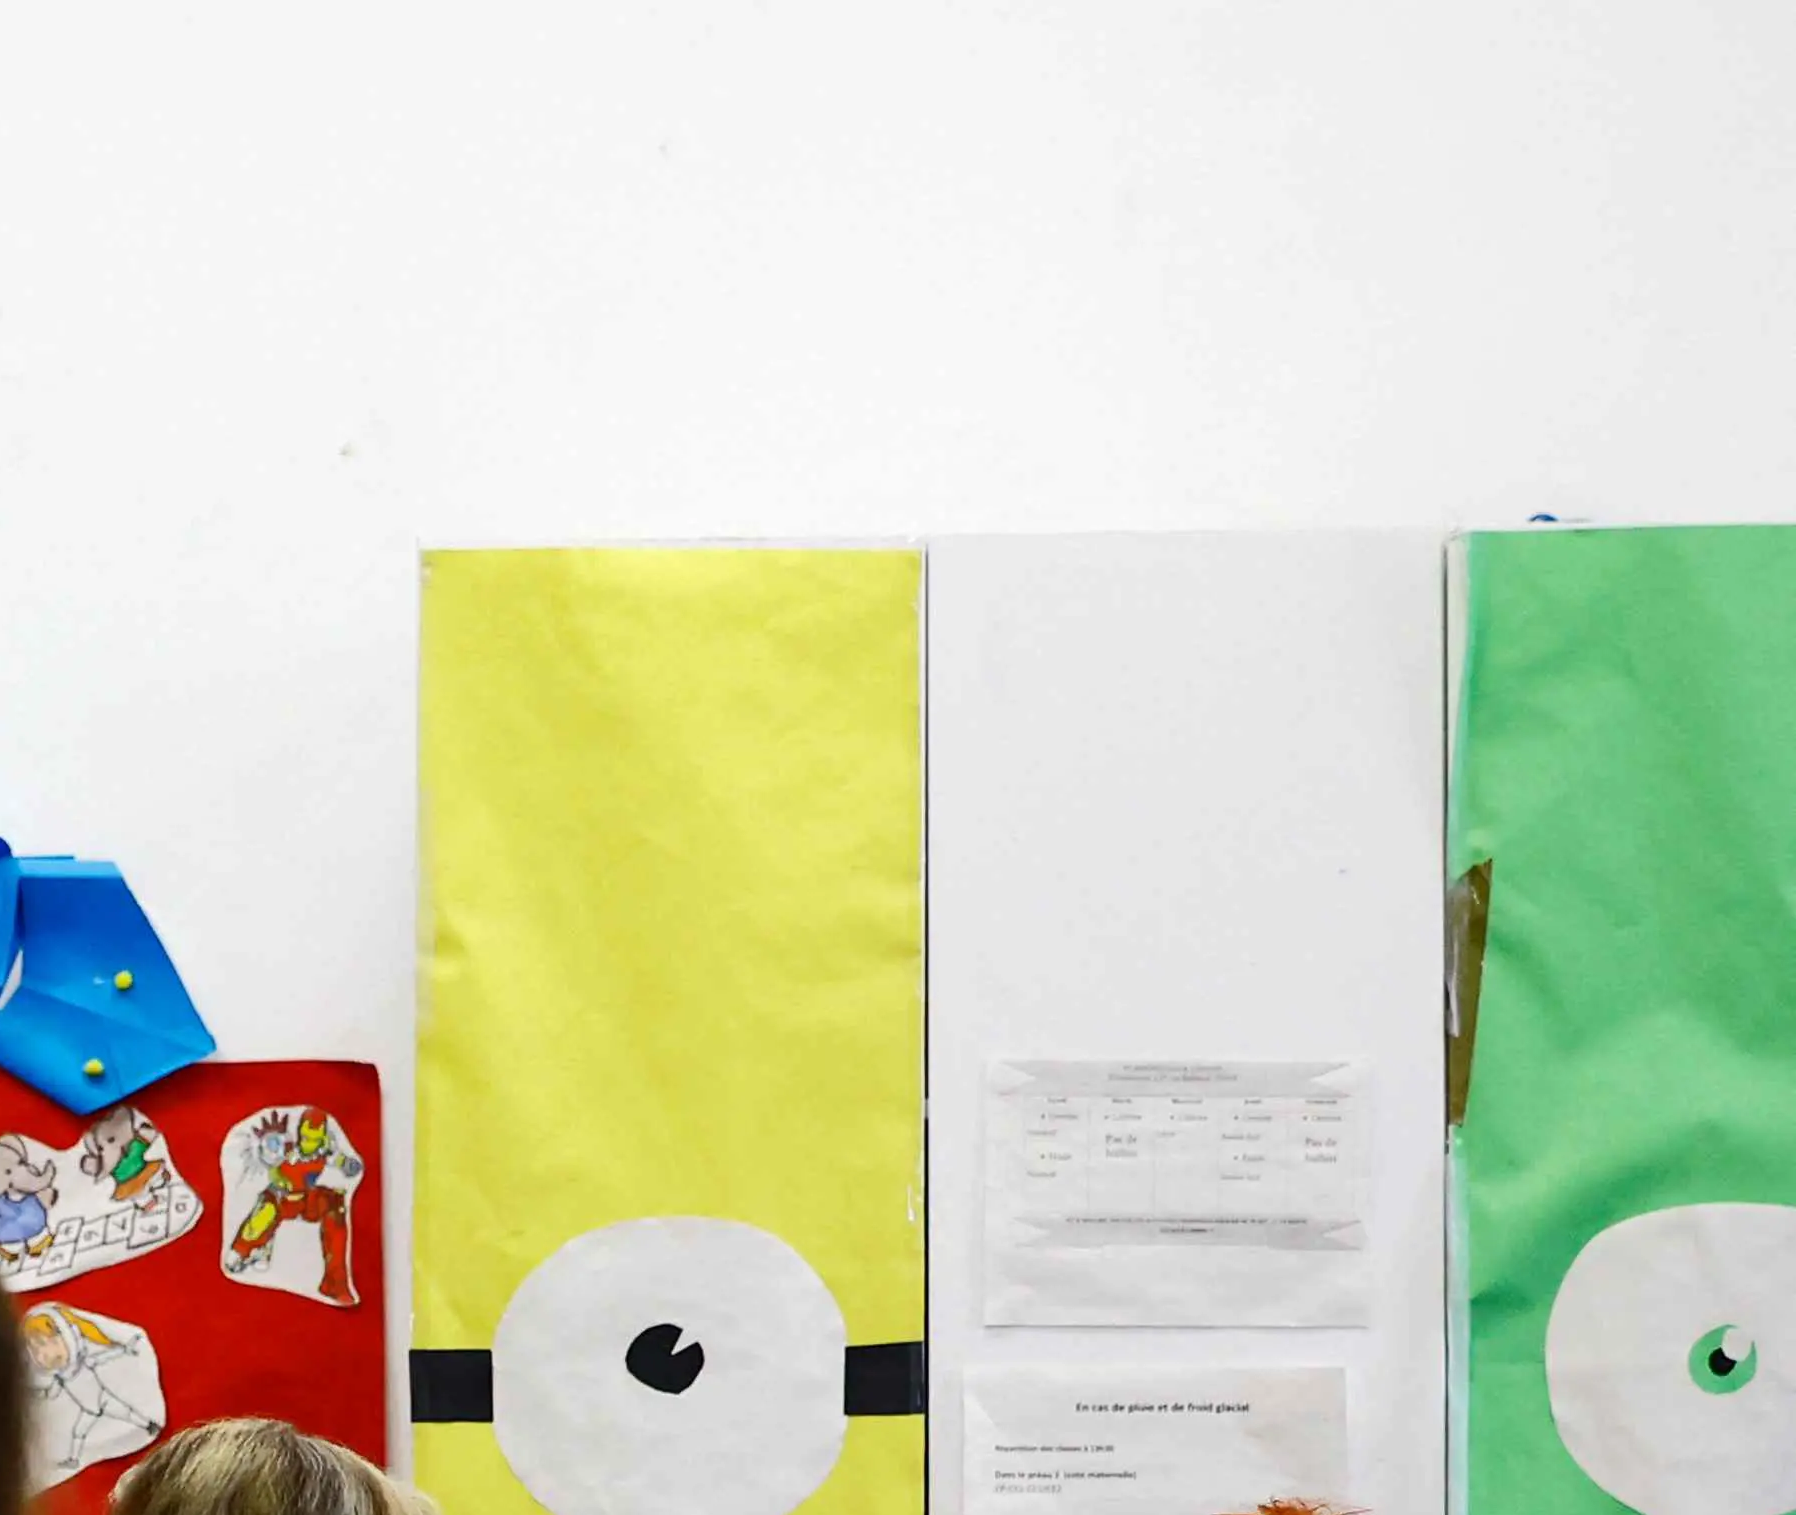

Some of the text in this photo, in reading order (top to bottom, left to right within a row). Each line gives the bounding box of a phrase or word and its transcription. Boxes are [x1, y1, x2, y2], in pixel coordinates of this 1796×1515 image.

[1075, 1402, 1089, 1412] En
[1092, 1404, 1109, 1412] cas
[1111, 1402, 1125, 1412] de
[1158, 1403, 1169, 1412] et
[1171, 1402, 1185, 1412] de
[1215, 1402, 1250, 1414] glacial
